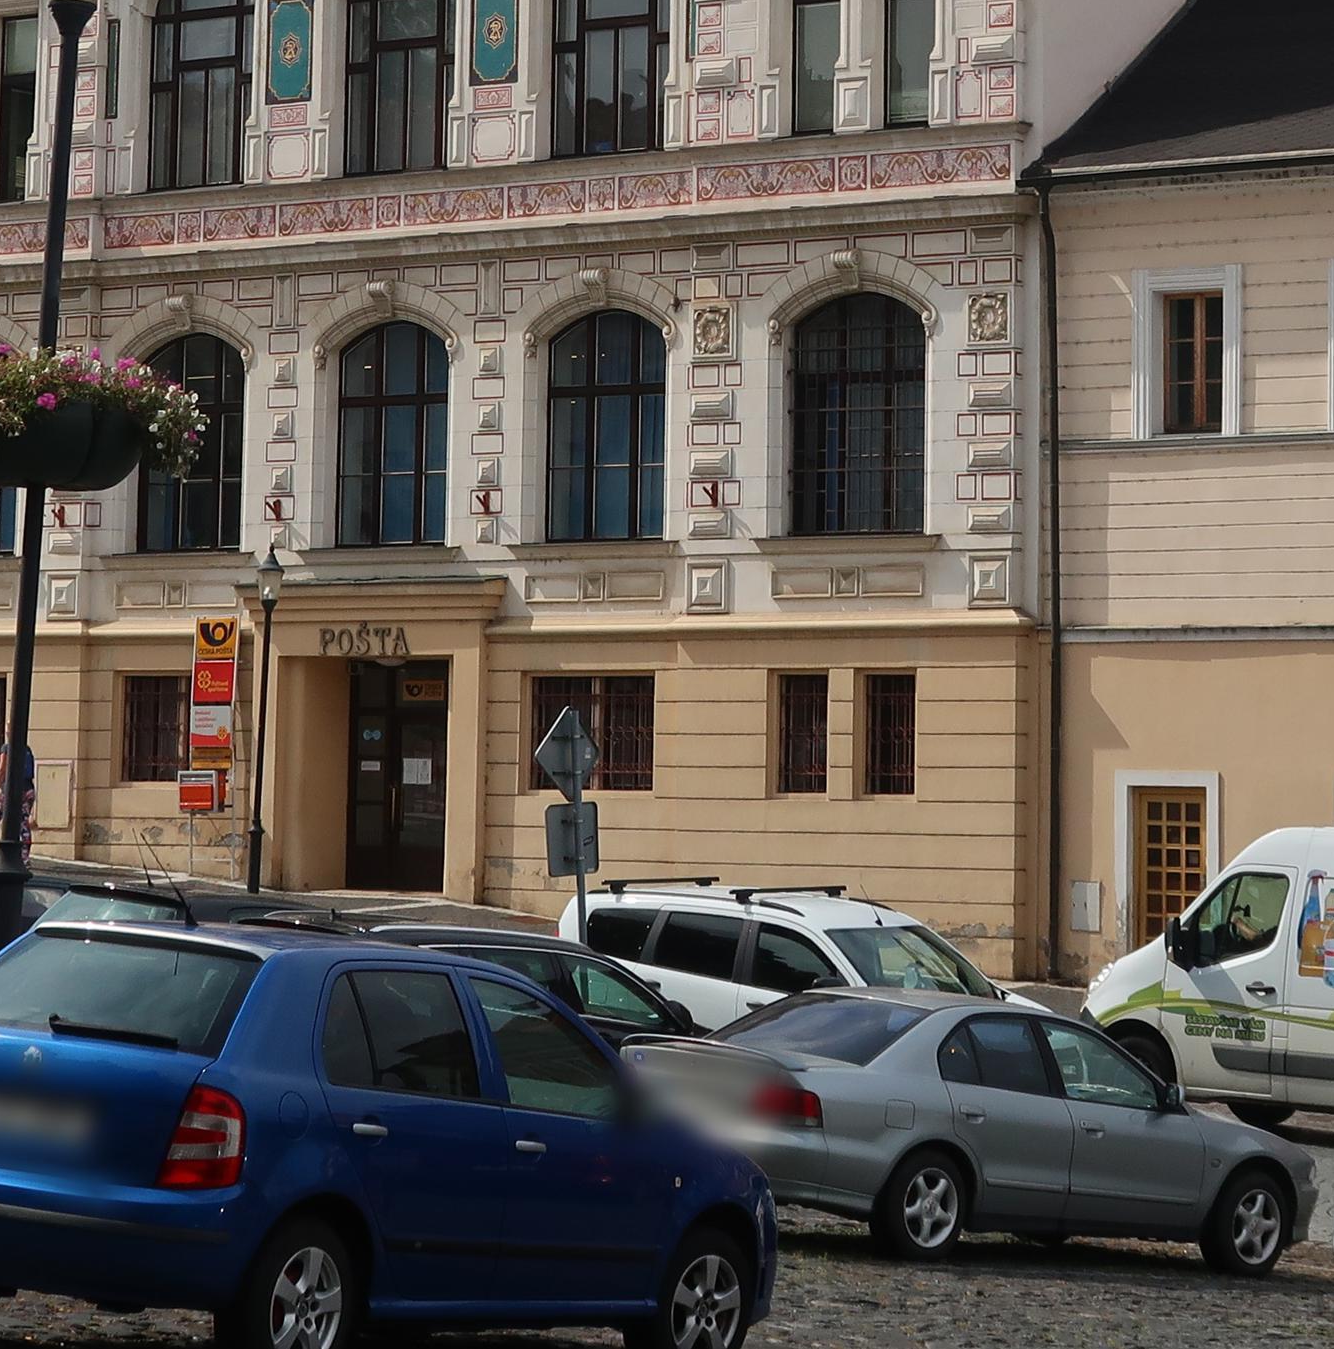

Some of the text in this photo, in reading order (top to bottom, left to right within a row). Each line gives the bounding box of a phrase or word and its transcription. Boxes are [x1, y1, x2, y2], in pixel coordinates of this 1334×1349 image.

[318, 621, 411, 656] POŠTA
[1185, 1025, 1214, 1038] CENY
[1215, 1027, 1233, 1039] NA
